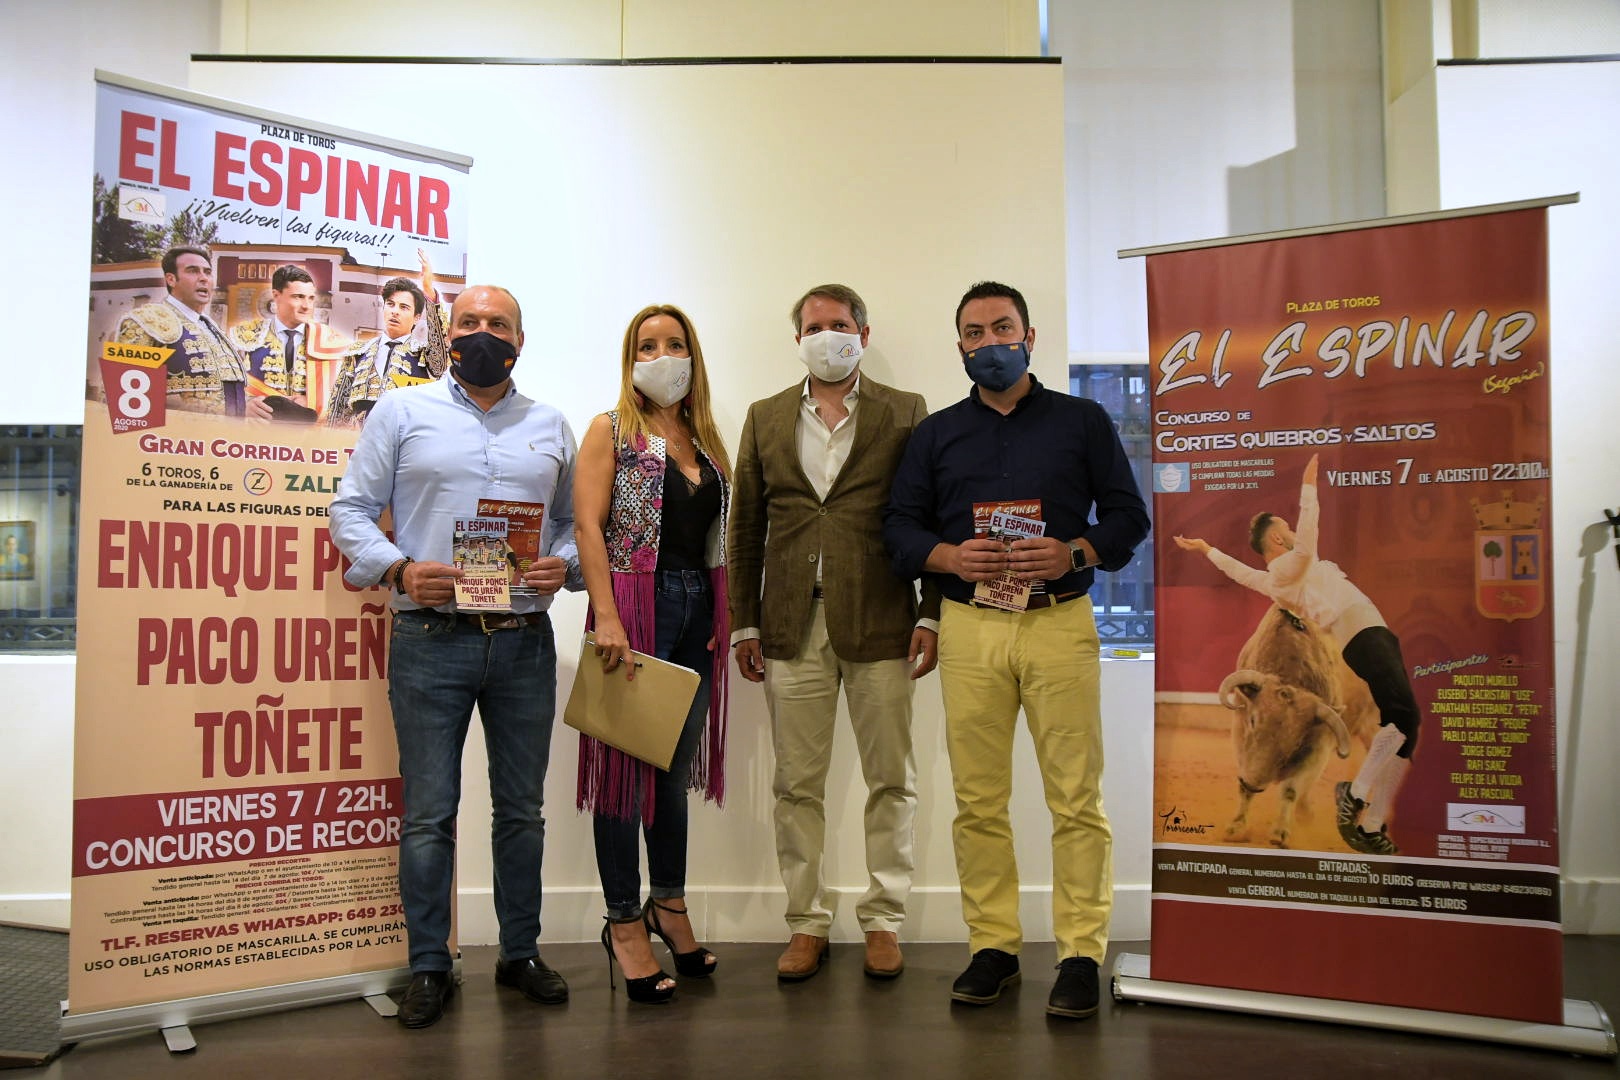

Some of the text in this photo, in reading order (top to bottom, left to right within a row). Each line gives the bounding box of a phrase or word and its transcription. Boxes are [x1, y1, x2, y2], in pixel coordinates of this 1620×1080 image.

[261, 124, 336, 150] PLAZA DE TOROS
[119, 109, 451, 240] EL ESPINAR
[184, 197, 394, 249] ¡¡Vuelven las figuras!!
[1286, 295, 1381, 313] PLAZA DE TOROS
[107, 346, 161, 361] SÁBADO
[1257, 309, 1538, 389] ESPINAR
[118, 369, 151, 419] 8
[114, 418, 148, 427] AGOSTO
[1155, 410, 1251, 426] CONCURSO DE
[1155, 422, 1437, 453] CORTES QUIEBROS Y SALTOS
[139, 434, 204, 457] GRAN
[210, 440, 305, 463] CORRIDA
[311, 449, 338, 465] DE
[141, 463, 219, 481] 6 TOROS, 6
[1203, 460, 1232, 468] OBLIGATORIO
[1327, 470, 1391, 487] VIERNES
[1396, 458, 1414, 485] 7
[1419, 473, 1432, 483] DE
[1434, 467, 1488, 482] AGOSTO
[126, 479, 233, 491] DE LA GANADERÍA DE
[163, 500, 330, 517] PARA LAS FIGURAS DEL
[497, 505, 541, 517] ESPINAR
[455, 521, 506, 532] EL ESPINAR
[992, 515, 1043, 535] EL ESPINAR
[98, 519, 298, 598] ENRIQUE
[456, 577, 508, 587] ENRIQUE PONCE
[462, 586, 479, 594] PACO
[137, 602, 391, 685] PACO UREÑ
[1413, 654, 1489, 679] Participantes
[1453, 674, 1519, 686] PAQUITO MURILLO
[1437, 689, 1468, 699] EUSEBIO
[1431, 702, 1471, 713] JONATHAN
[1442, 716, 1465, 727] DAVID
[1466, 717, 1498, 728] RAMIREZ
[194, 693, 363, 779] TOÑETE
[1442, 731, 1467, 741] PABLO
[1468, 731, 1496, 742] GARCIA
[1461, 745, 1512, 757] JORGE GOMEZ
[1467, 759, 1507, 771] RAFI SANZ
[1450, 772, 1523, 786] FELIPE DE LA VIUDA
[1459, 787, 1515, 800] ALEX PASCUAL
[158, 784, 393, 827] VIERNES 7 / 22H.
[86, 816, 400, 870] CONCURSO DE RECOR
[1158, 863, 1175, 871] VENTA
[1176, 861, 1228, 874] ANTICIPADA
[1229, 868, 1253, 877] GENERAL
[1255, 869, 1285, 878] NUMERADA
[1287, 871, 1307, 879] HASTA
[1307, 872, 1315, 880] EL
[1316, 872, 1326, 881] DIA
[1334, 874, 1342, 882] DE
[1343, 875, 1367, 884] AGOSTO
[1369, 874, 1380, 884] 10
[1383, 875, 1414, 887] EUROS
[1417, 879, 1450, 889] (RESERVA
[1452, 881, 1468, 890] POR
[1469, 882, 1501, 892] WASSAP
[1319, 860, 1371, 875] ENTRADAS:
[1228, 886, 1246, 895] VENTA
[1248, 885, 1285, 897] GENERAL
[1287, 890, 1318, 900] NUMERADA
[1320, 891, 1328, 900] EN
[1329, 893, 1357, 903] TAQUILLA
[1367, 896, 1378, 904] DIA
[1380, 897, 1390, 905] DEL
[1420, 896, 1432, 908] 15
[1434, 898, 1468, 911] EUROS
[100, 936, 141, 952] TLF.
[145, 923, 240, 947] RESERVAS
[243, 911, 343, 934] WHATSAPP:
[346, 906, 377, 921] 649
[84, 920, 407, 972] USO OBLIGATORIO DE MASCARILLA. SE CUMPLIRÁN
[144, 935, 403, 978] LAS NORMAS ESTABLECIDAS POR LA JCYL
